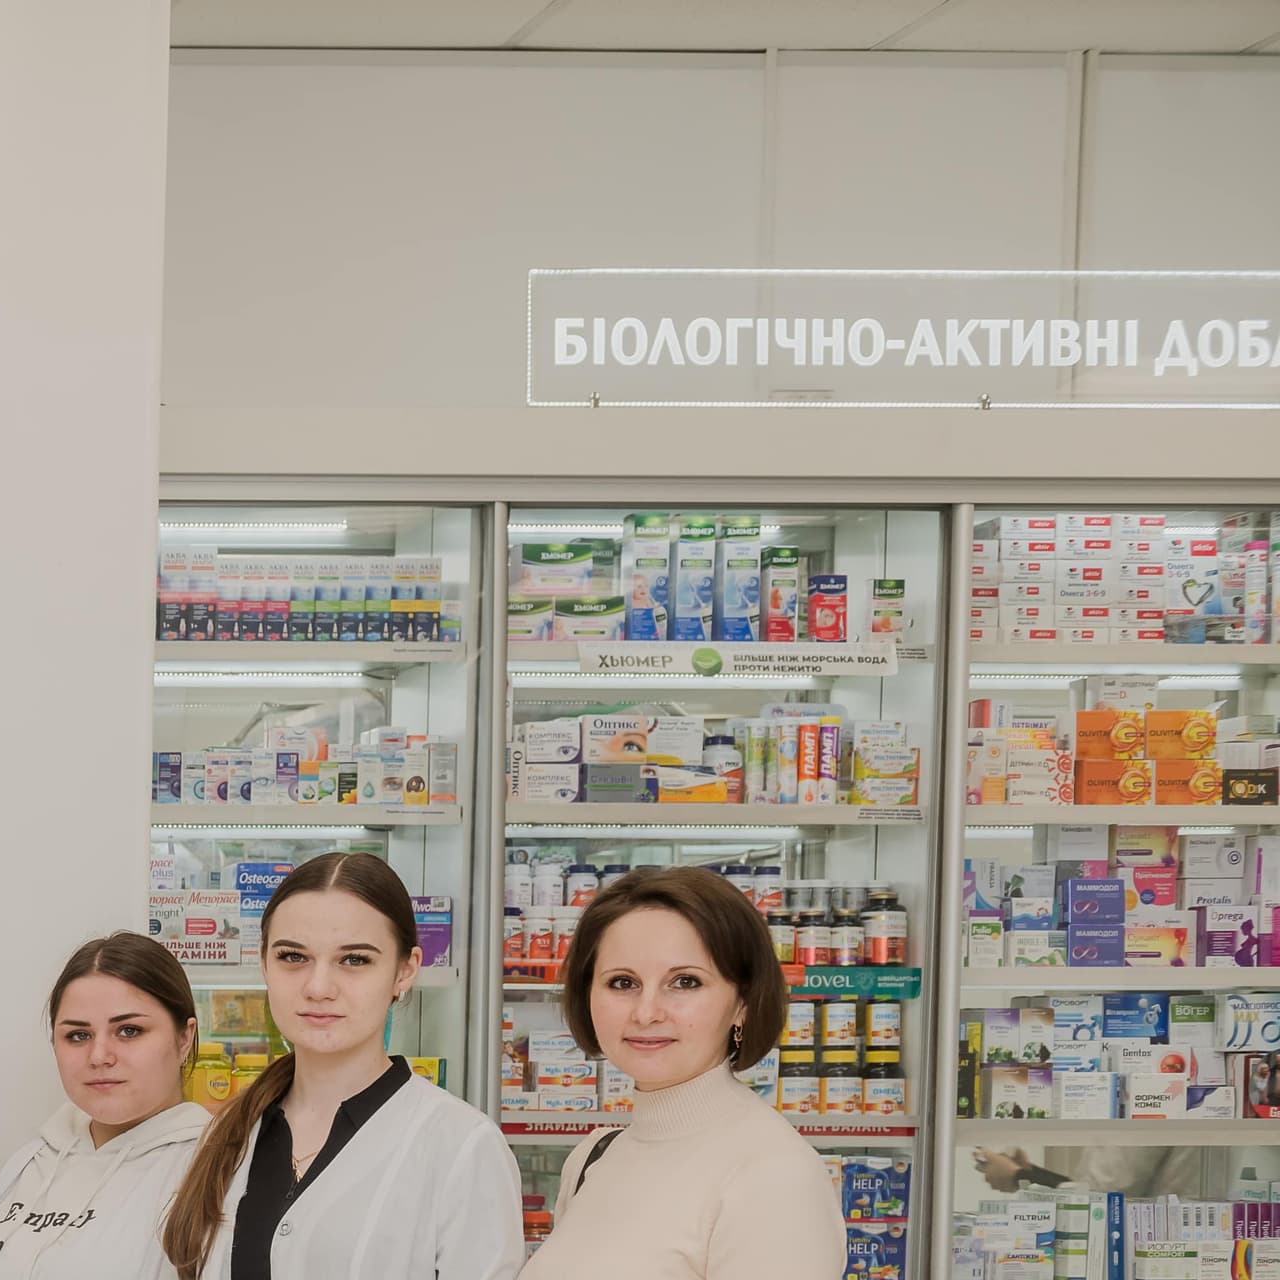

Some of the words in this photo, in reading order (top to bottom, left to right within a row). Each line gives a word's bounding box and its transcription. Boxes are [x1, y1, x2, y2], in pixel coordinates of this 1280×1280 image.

[553, 318, 1138, 366] БІОЛОГІЧНО-АКТИВНІ
[1154, 318, 1280, 376] ДОБ
[681, 527, 714, 535] ХЬЮМЕР
[727, 527, 759, 536] ХЬЮМЕР
[598, 654, 673, 669] ХЬЮМЕР
[733, 655, 775, 663] БІЛЬШЕ
[777, 655, 801, 663] НІЖ
[802, 655, 855, 663] МОРСЬКА
[857, 656, 888, 664] ВОДА
[773, 665, 823, 673] НЕЖИТЮ
[593, 718, 640, 730] Оптикс
[528, 732, 573, 740] КОМПЛЕКС
[803, 732, 815, 776] ПАМП
[821, 732, 834, 775] ПАМП
[511, 750, 523, 797] Оптикс
[152, 868, 174, 879] plus
[188, 891, 240, 906] Menopace
[1196, 896, 1232, 905] Protalis
[204, 941, 227, 949] НІЖ
[1122, 1048, 1153, 1057] Gentos
[1135, 1101, 1162, 1109] КОМБІ
[852, 1178, 883, 1190] HELP
[848, 1243, 879, 1254] HELP
